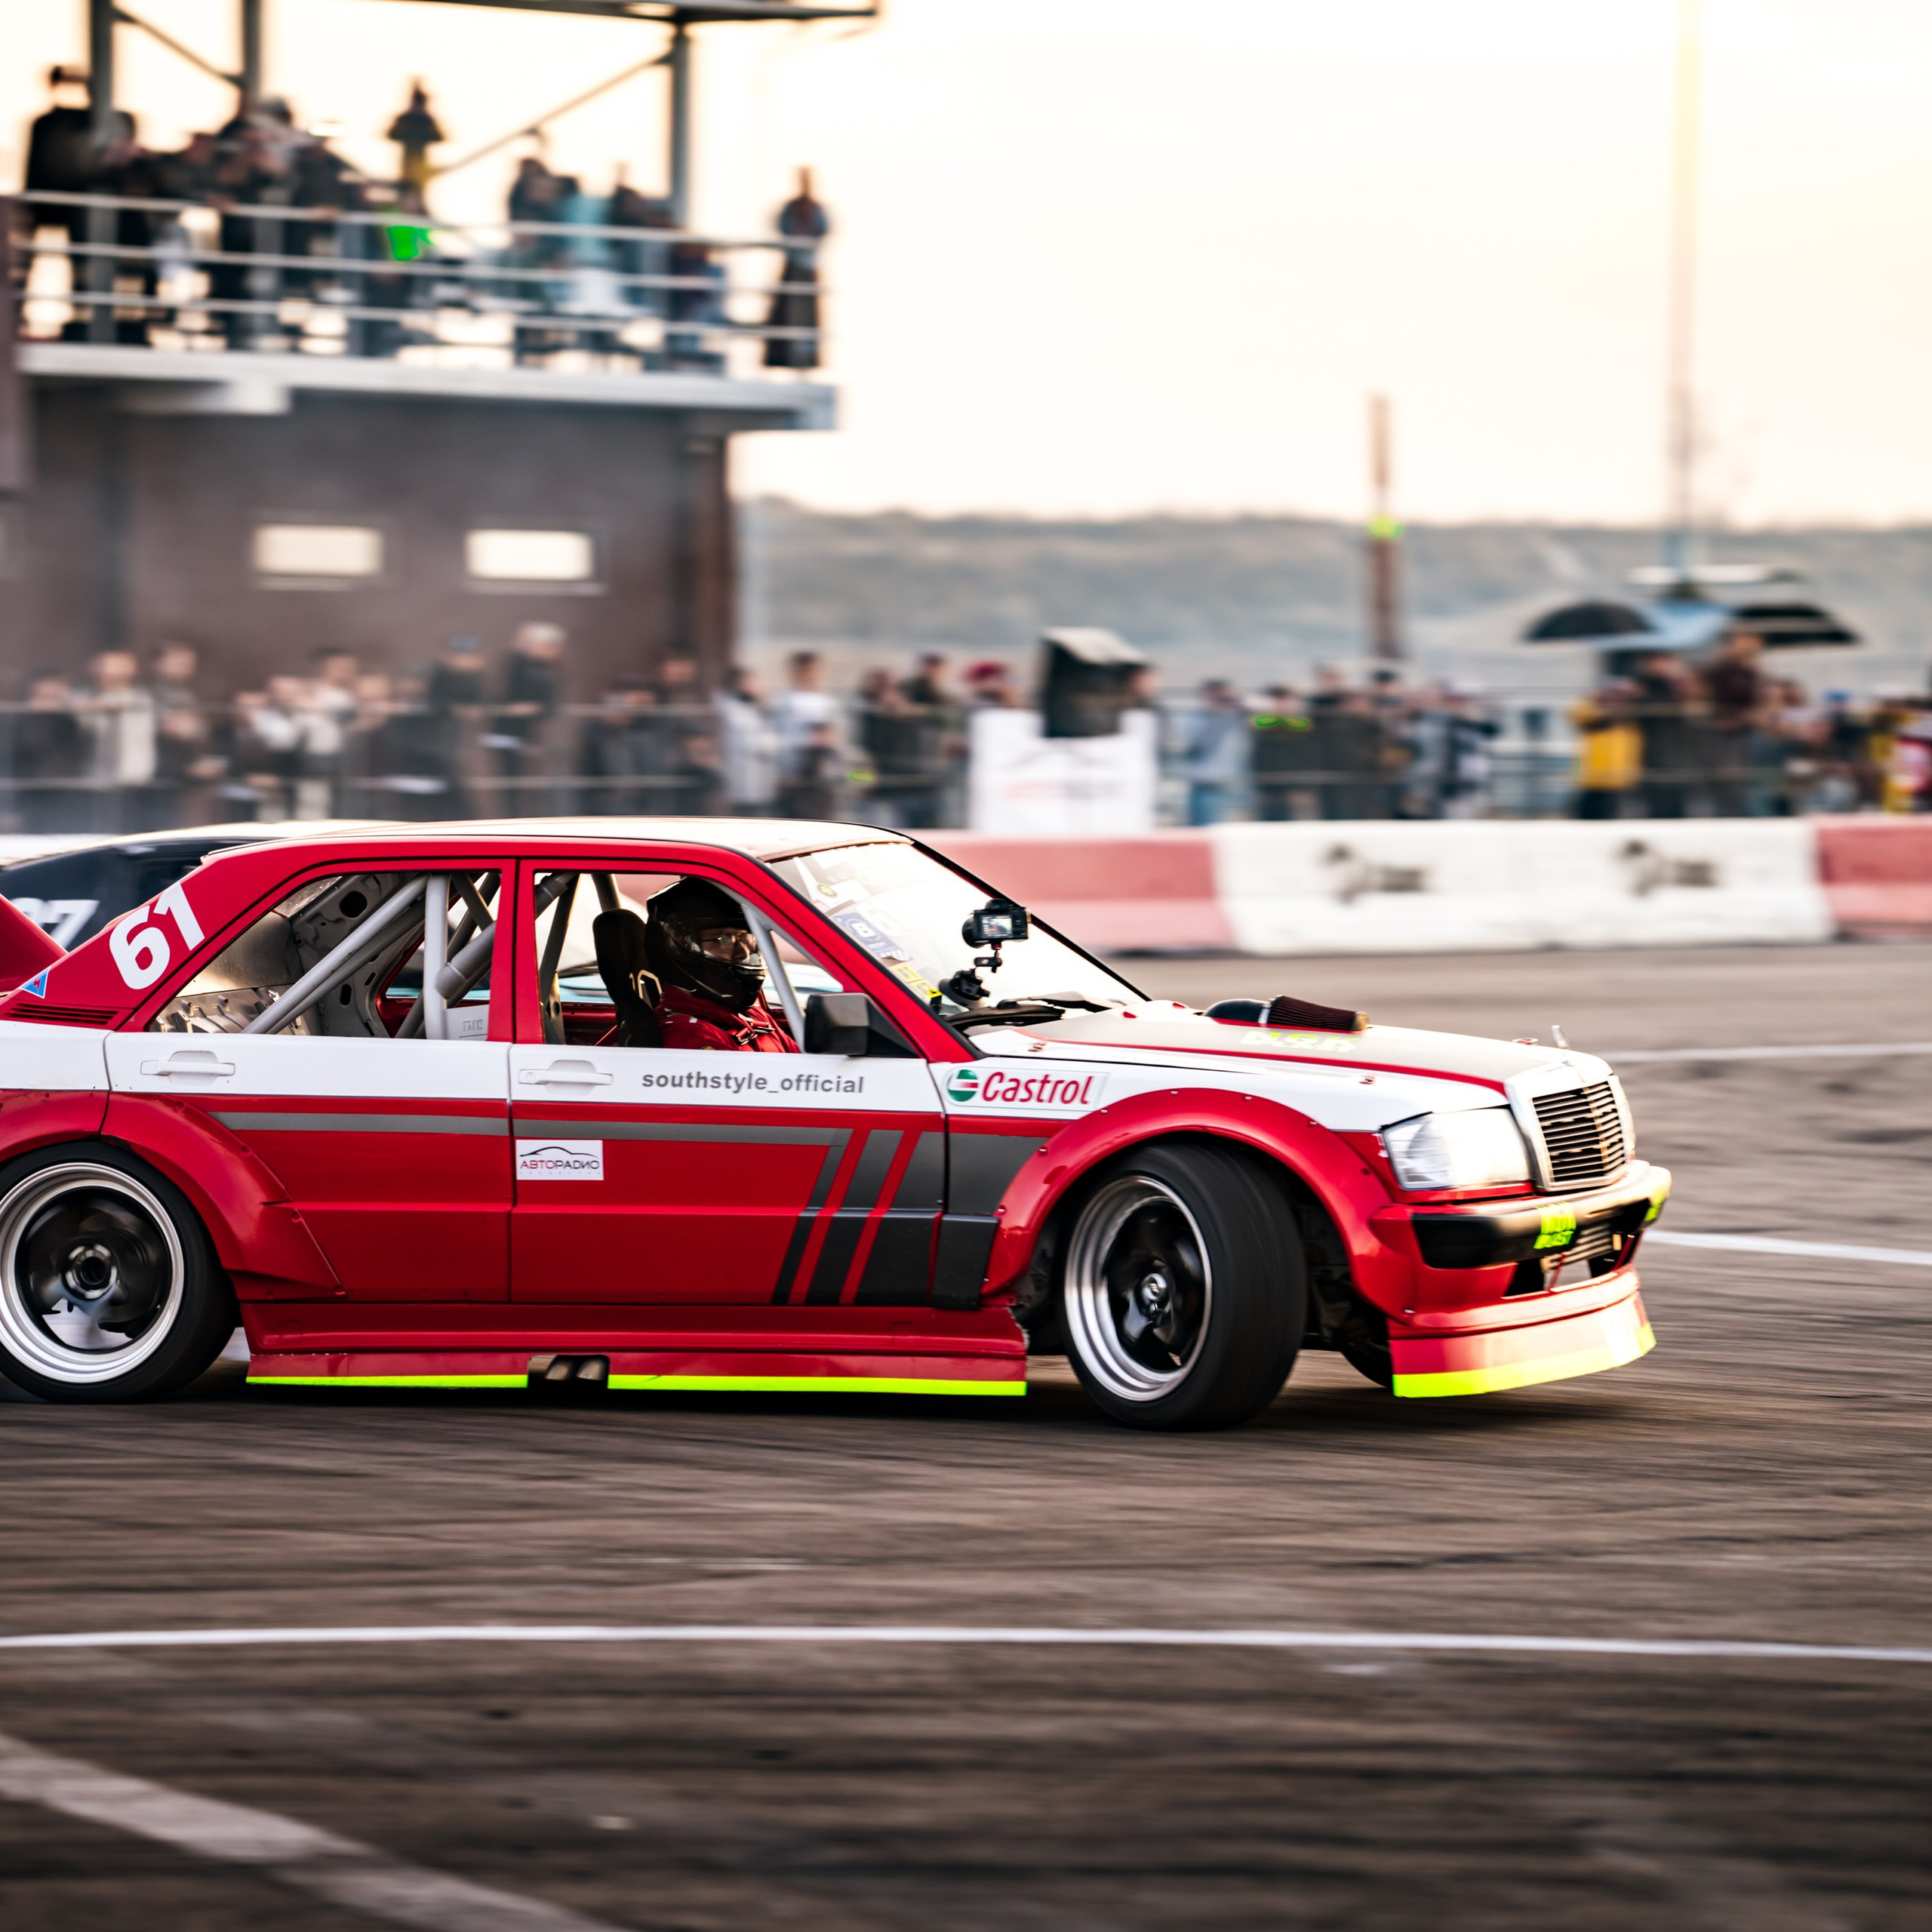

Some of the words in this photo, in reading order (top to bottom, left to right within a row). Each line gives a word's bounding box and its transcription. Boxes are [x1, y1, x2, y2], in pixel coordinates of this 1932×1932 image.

[109, 881, 205, 989] 61
[641, 1071, 864, 1094] southstyle_official
[982, 1072, 1094, 1105] Castrol
